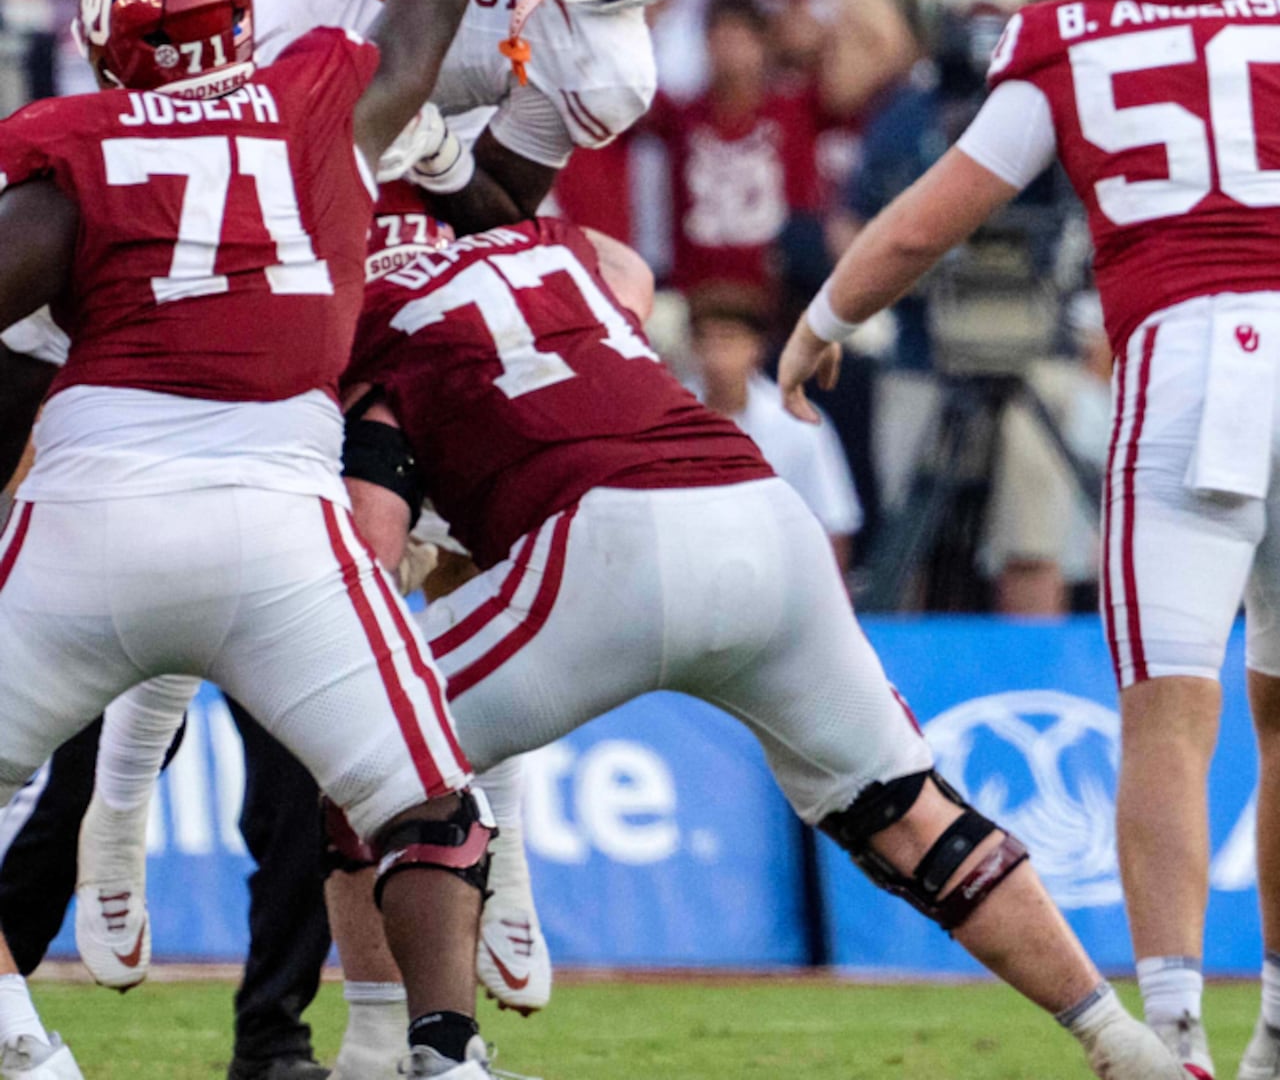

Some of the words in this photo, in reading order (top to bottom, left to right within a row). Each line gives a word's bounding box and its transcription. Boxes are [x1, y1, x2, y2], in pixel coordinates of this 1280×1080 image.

[1057, 3, 1098, 39] B.
[180, 34, 227, 74] 71
[118, 82, 280, 126] JOSEPH
[101, 135, 335, 305] 71
[376, 214, 429, 248] 77
[389, 243, 661, 400] 77
